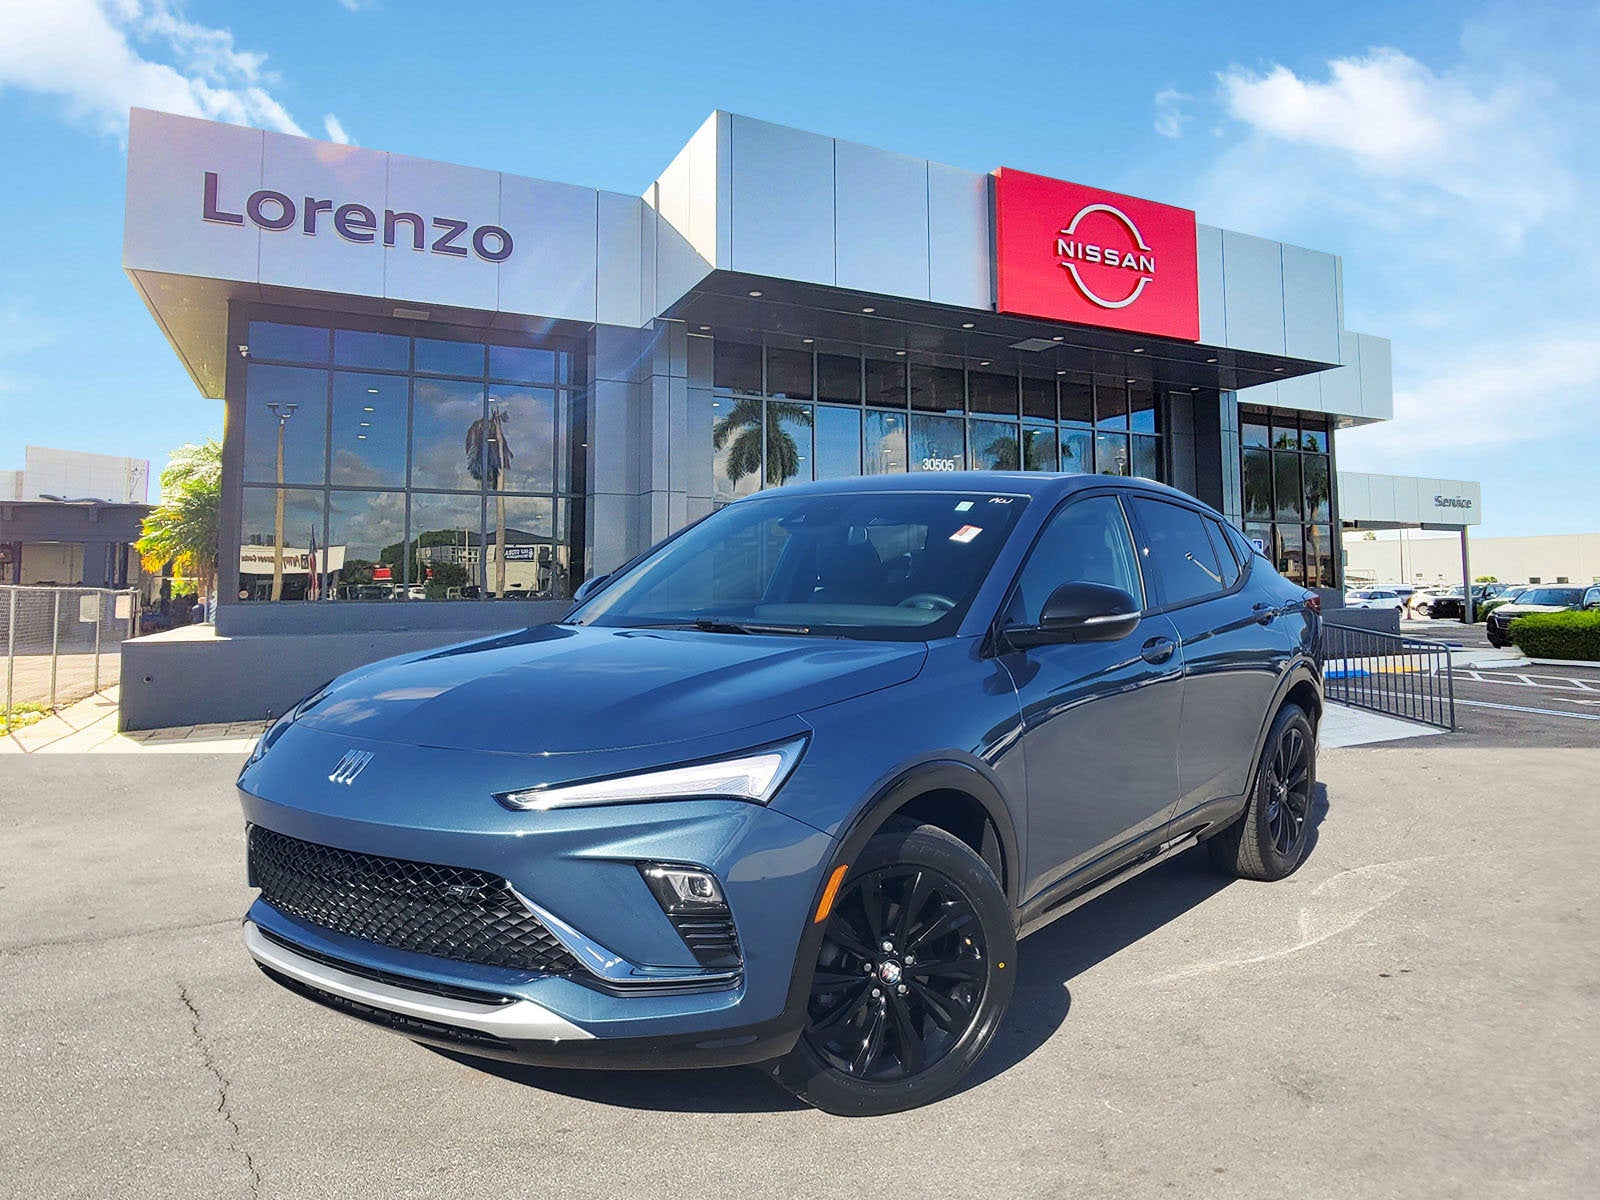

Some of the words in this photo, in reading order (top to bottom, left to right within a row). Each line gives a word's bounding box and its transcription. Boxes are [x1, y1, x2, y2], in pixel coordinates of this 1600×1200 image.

[202, 171, 515, 262] Lorenzo
[1057, 238, 1155, 273] NISSAN
[922, 458, 954, 471] 30505
[1434, 495, 1472, 508] Service
